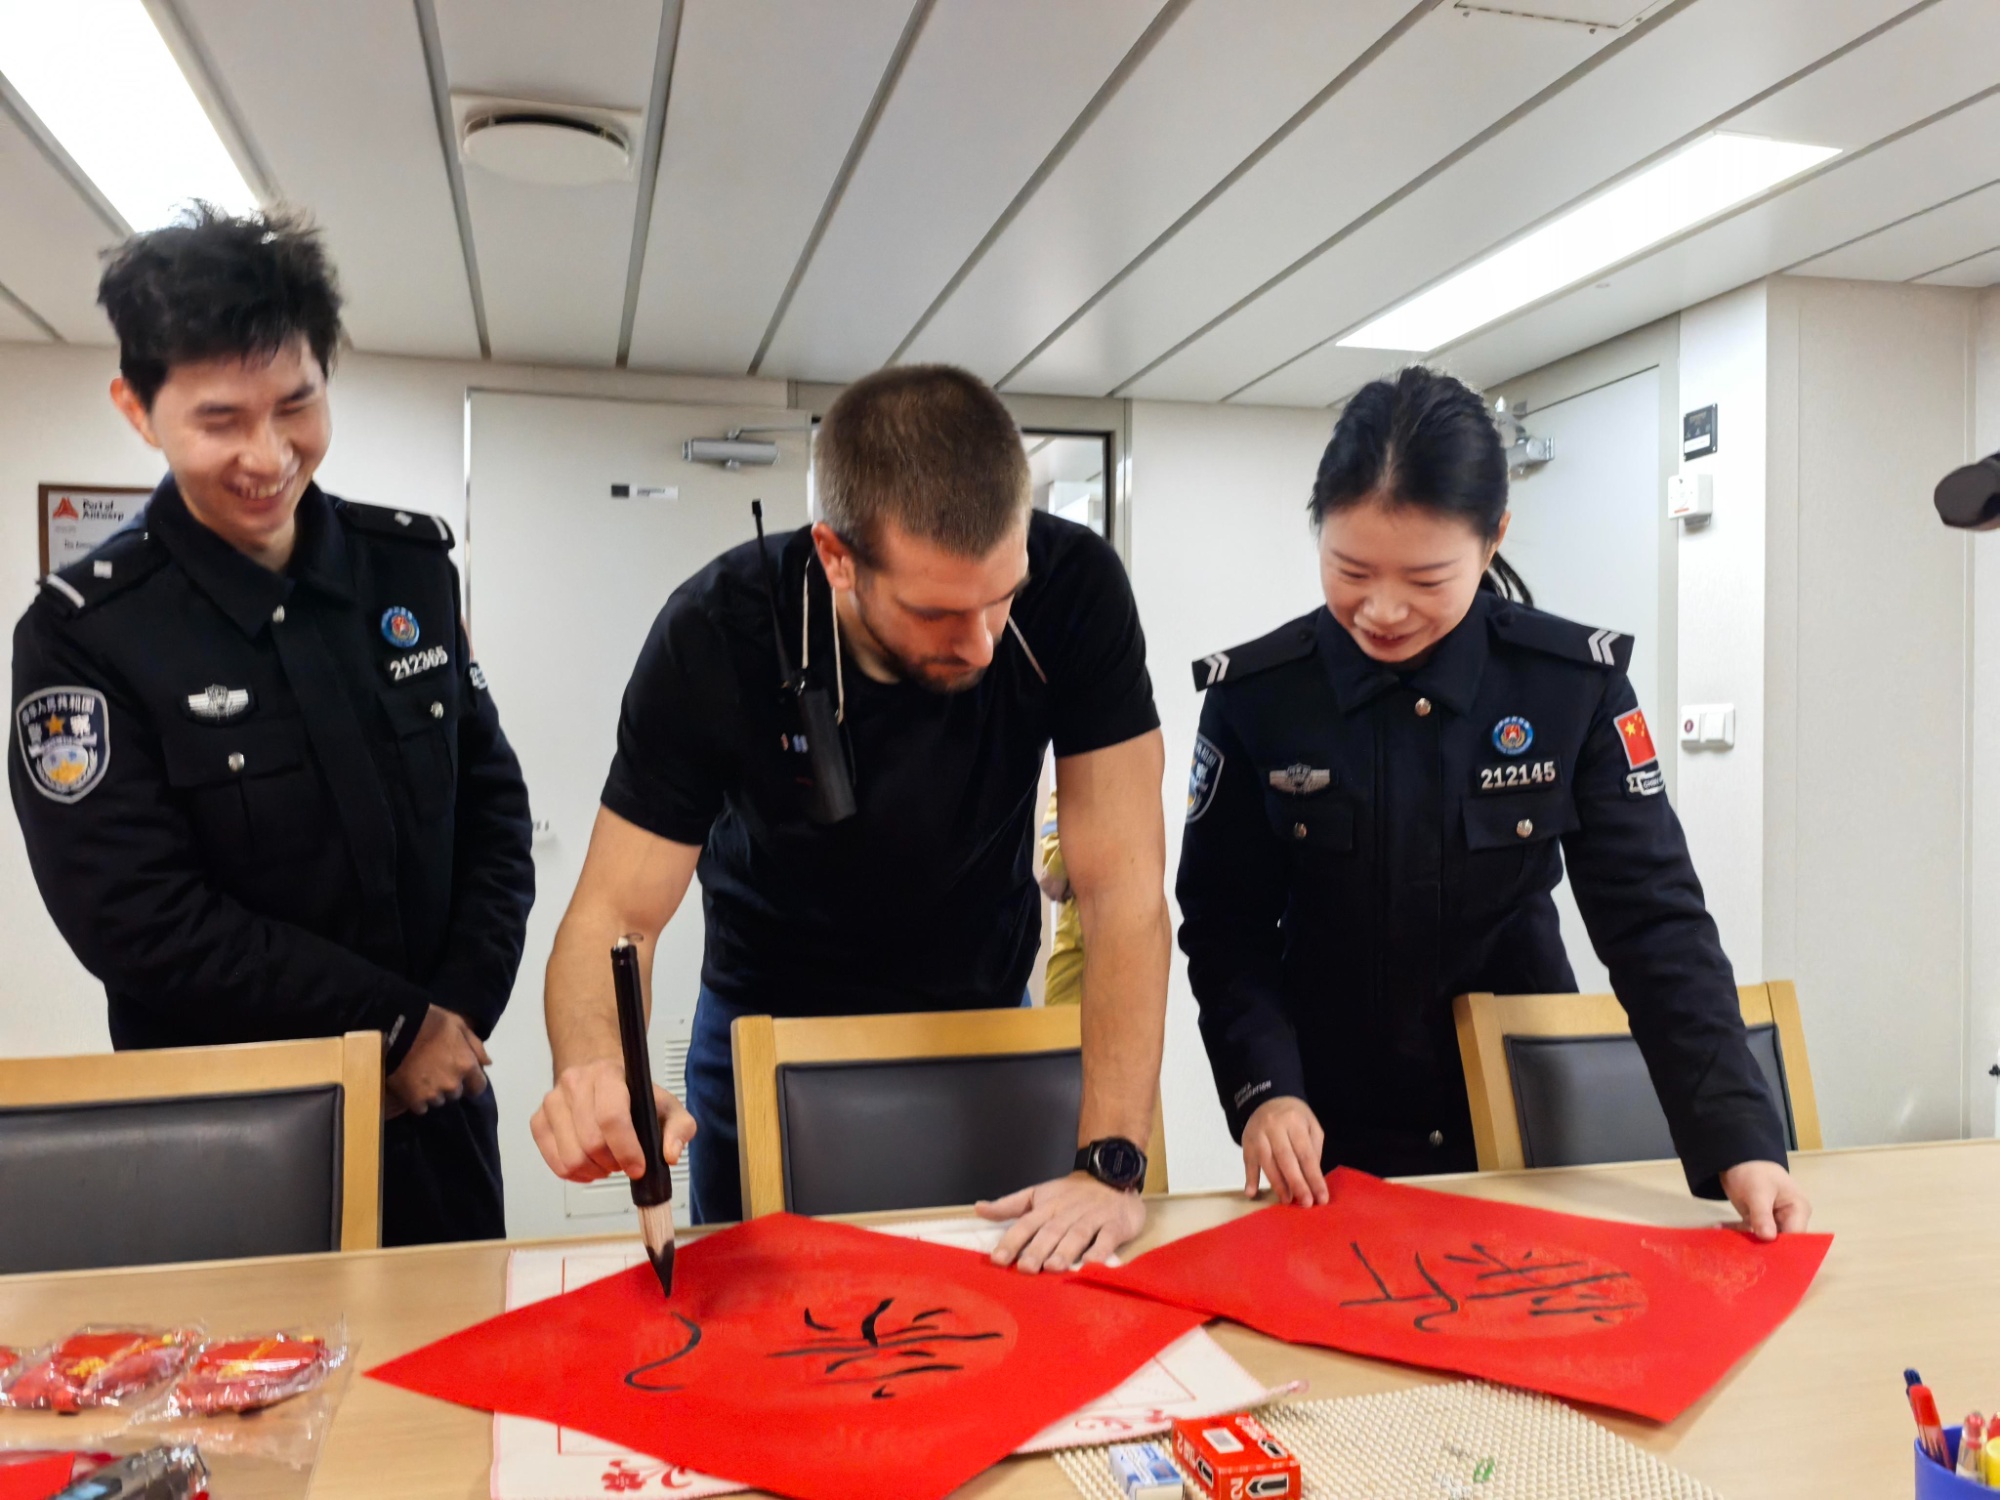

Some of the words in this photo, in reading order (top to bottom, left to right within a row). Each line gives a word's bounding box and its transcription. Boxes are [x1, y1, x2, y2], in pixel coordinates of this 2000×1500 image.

[83, 499, 103, 510] Port
[104, 500, 114, 511] of
[83, 510, 124, 522] Antwerp
[390, 645, 448, 681] 212365
[1480, 761, 1556, 790] 212145
